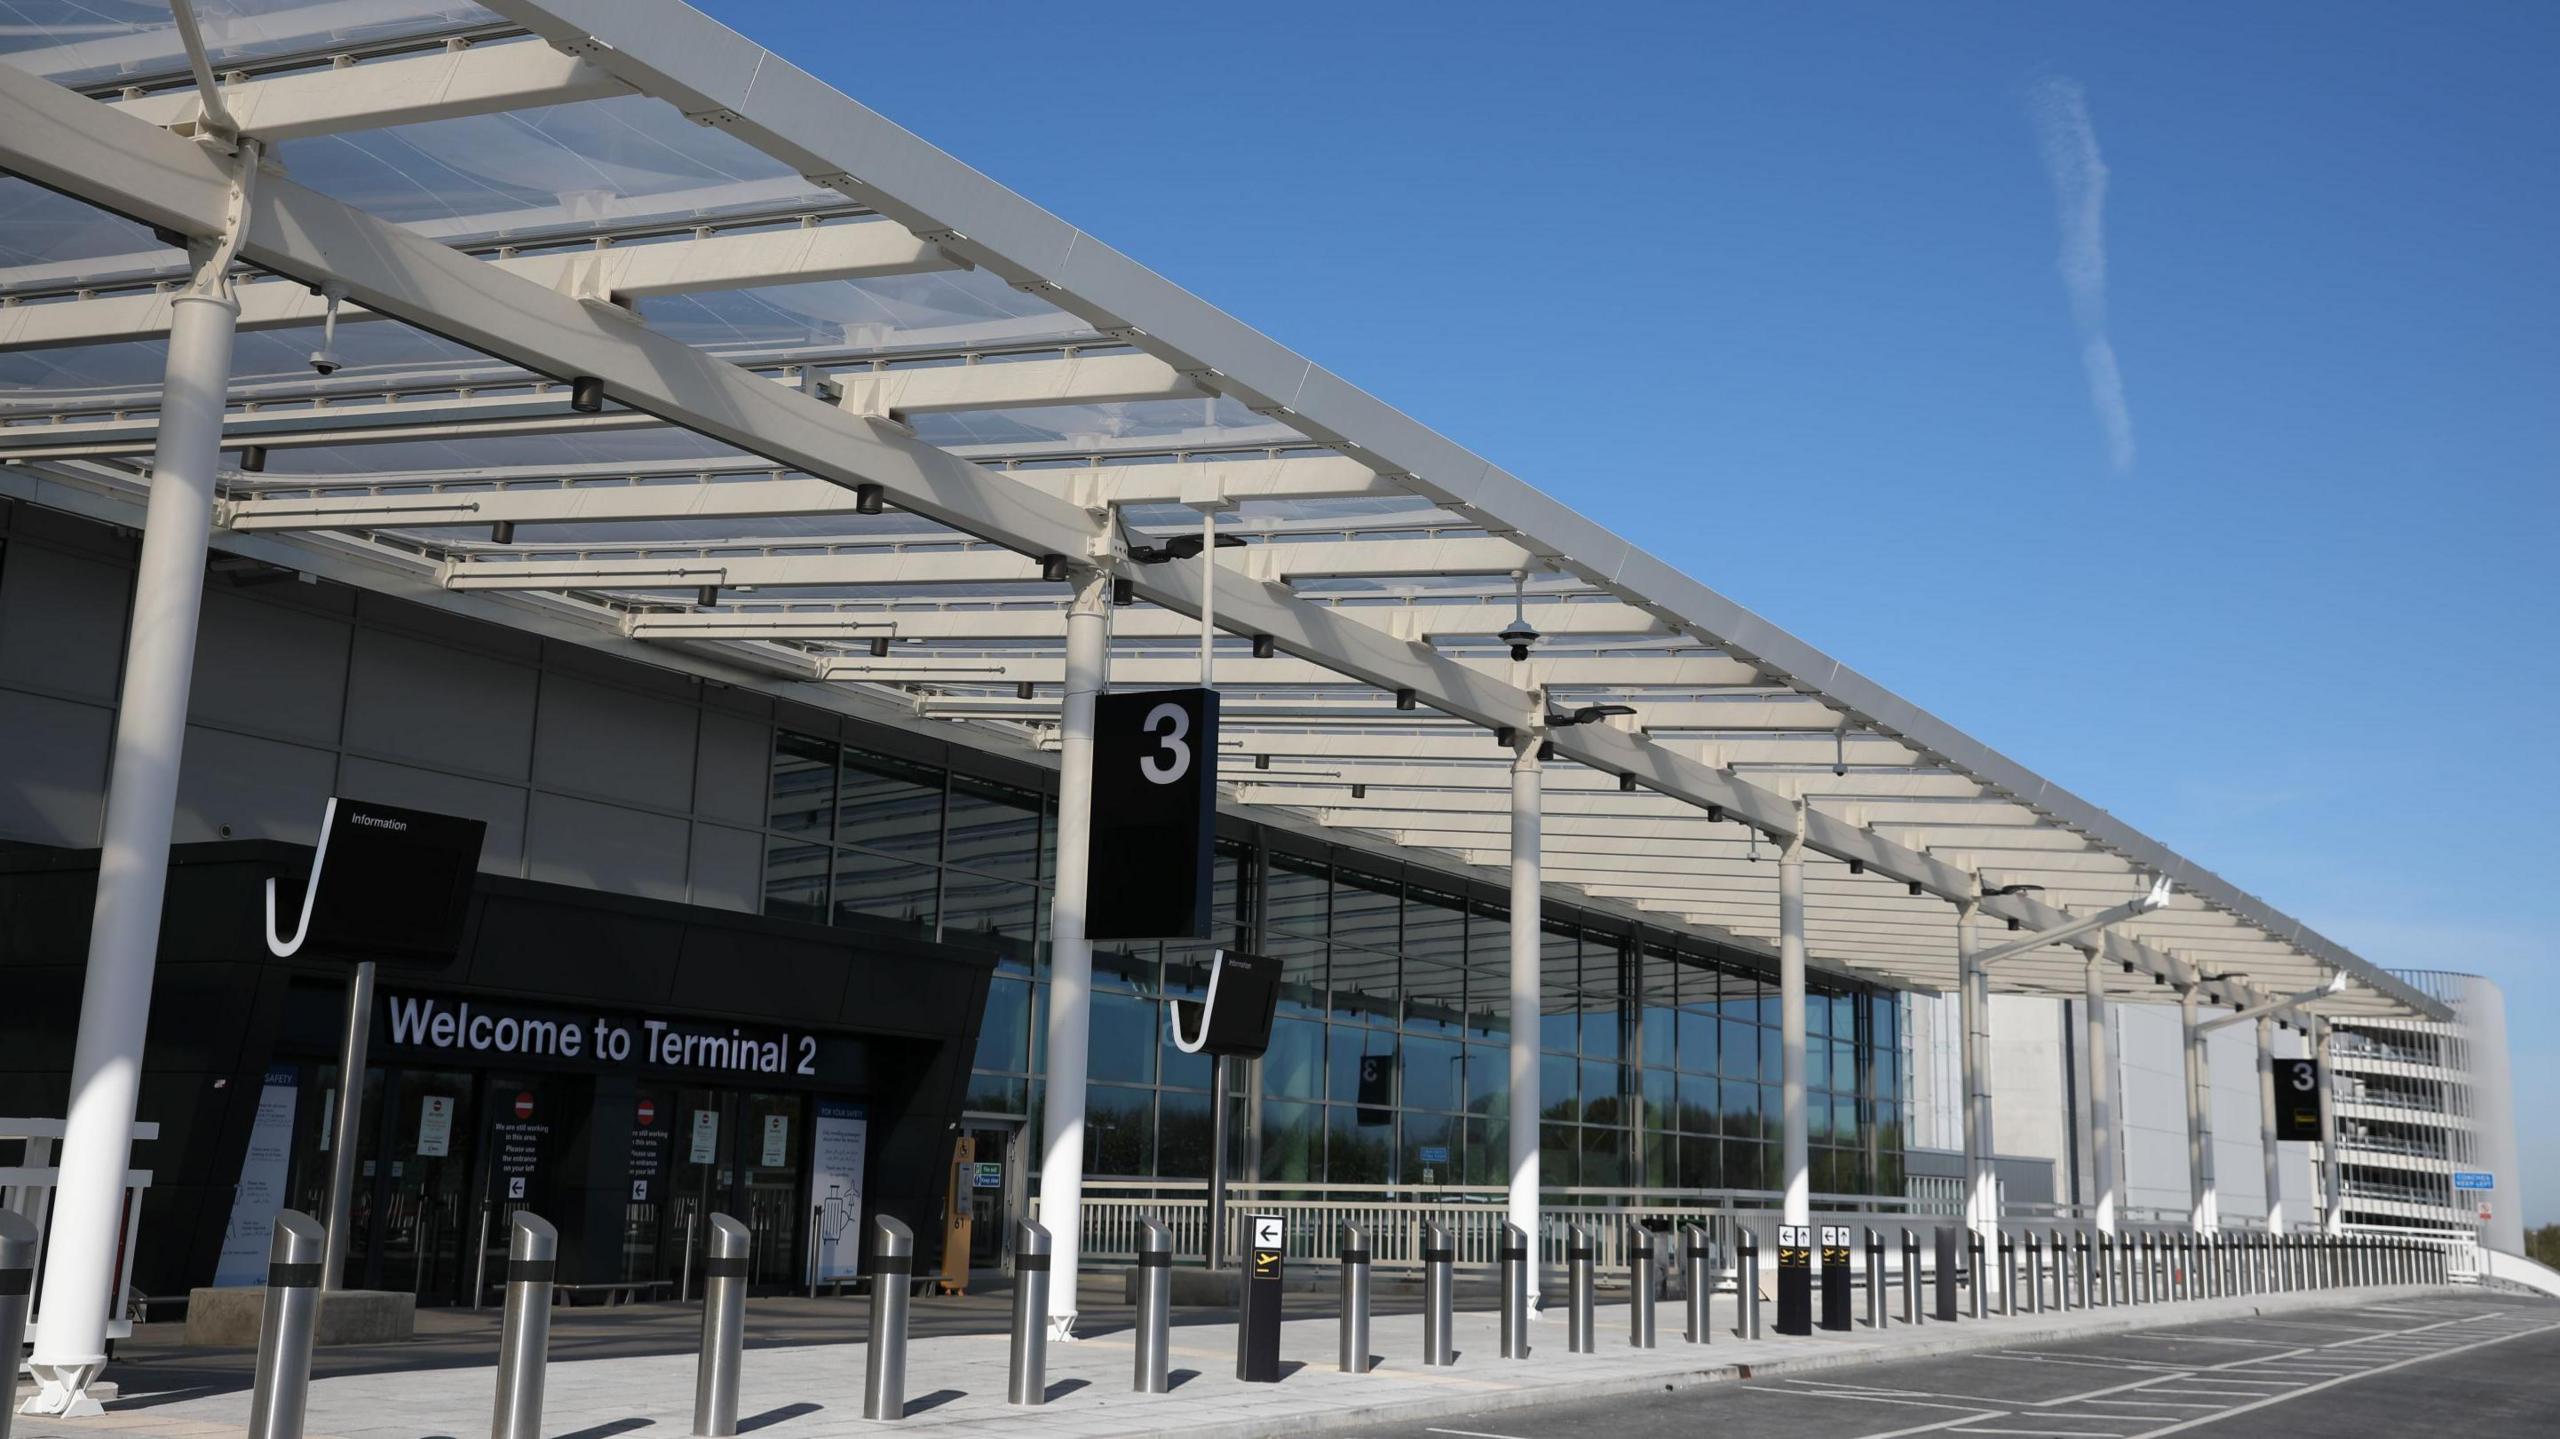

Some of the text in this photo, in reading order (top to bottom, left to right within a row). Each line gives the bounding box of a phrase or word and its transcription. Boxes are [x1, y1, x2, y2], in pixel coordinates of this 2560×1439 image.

[1140, 702, 1191, 786] 3
[352, 812, 407, 831] Information
[388, 996, 816, 1076] Welcome to Terminal 2
[264, 1072, 293, 1084] SAFETY
[2292, 1063, 2315, 1091] 3
[527, 1124, 549, 1134] working
[512, 1133, 523, 1141] this
[505, 1144, 524, 1153] Please
[512, 1166, 524, 1174] your
[525, 1164, 535, 1172] left
[954, 1217, 965, 1230] 61
